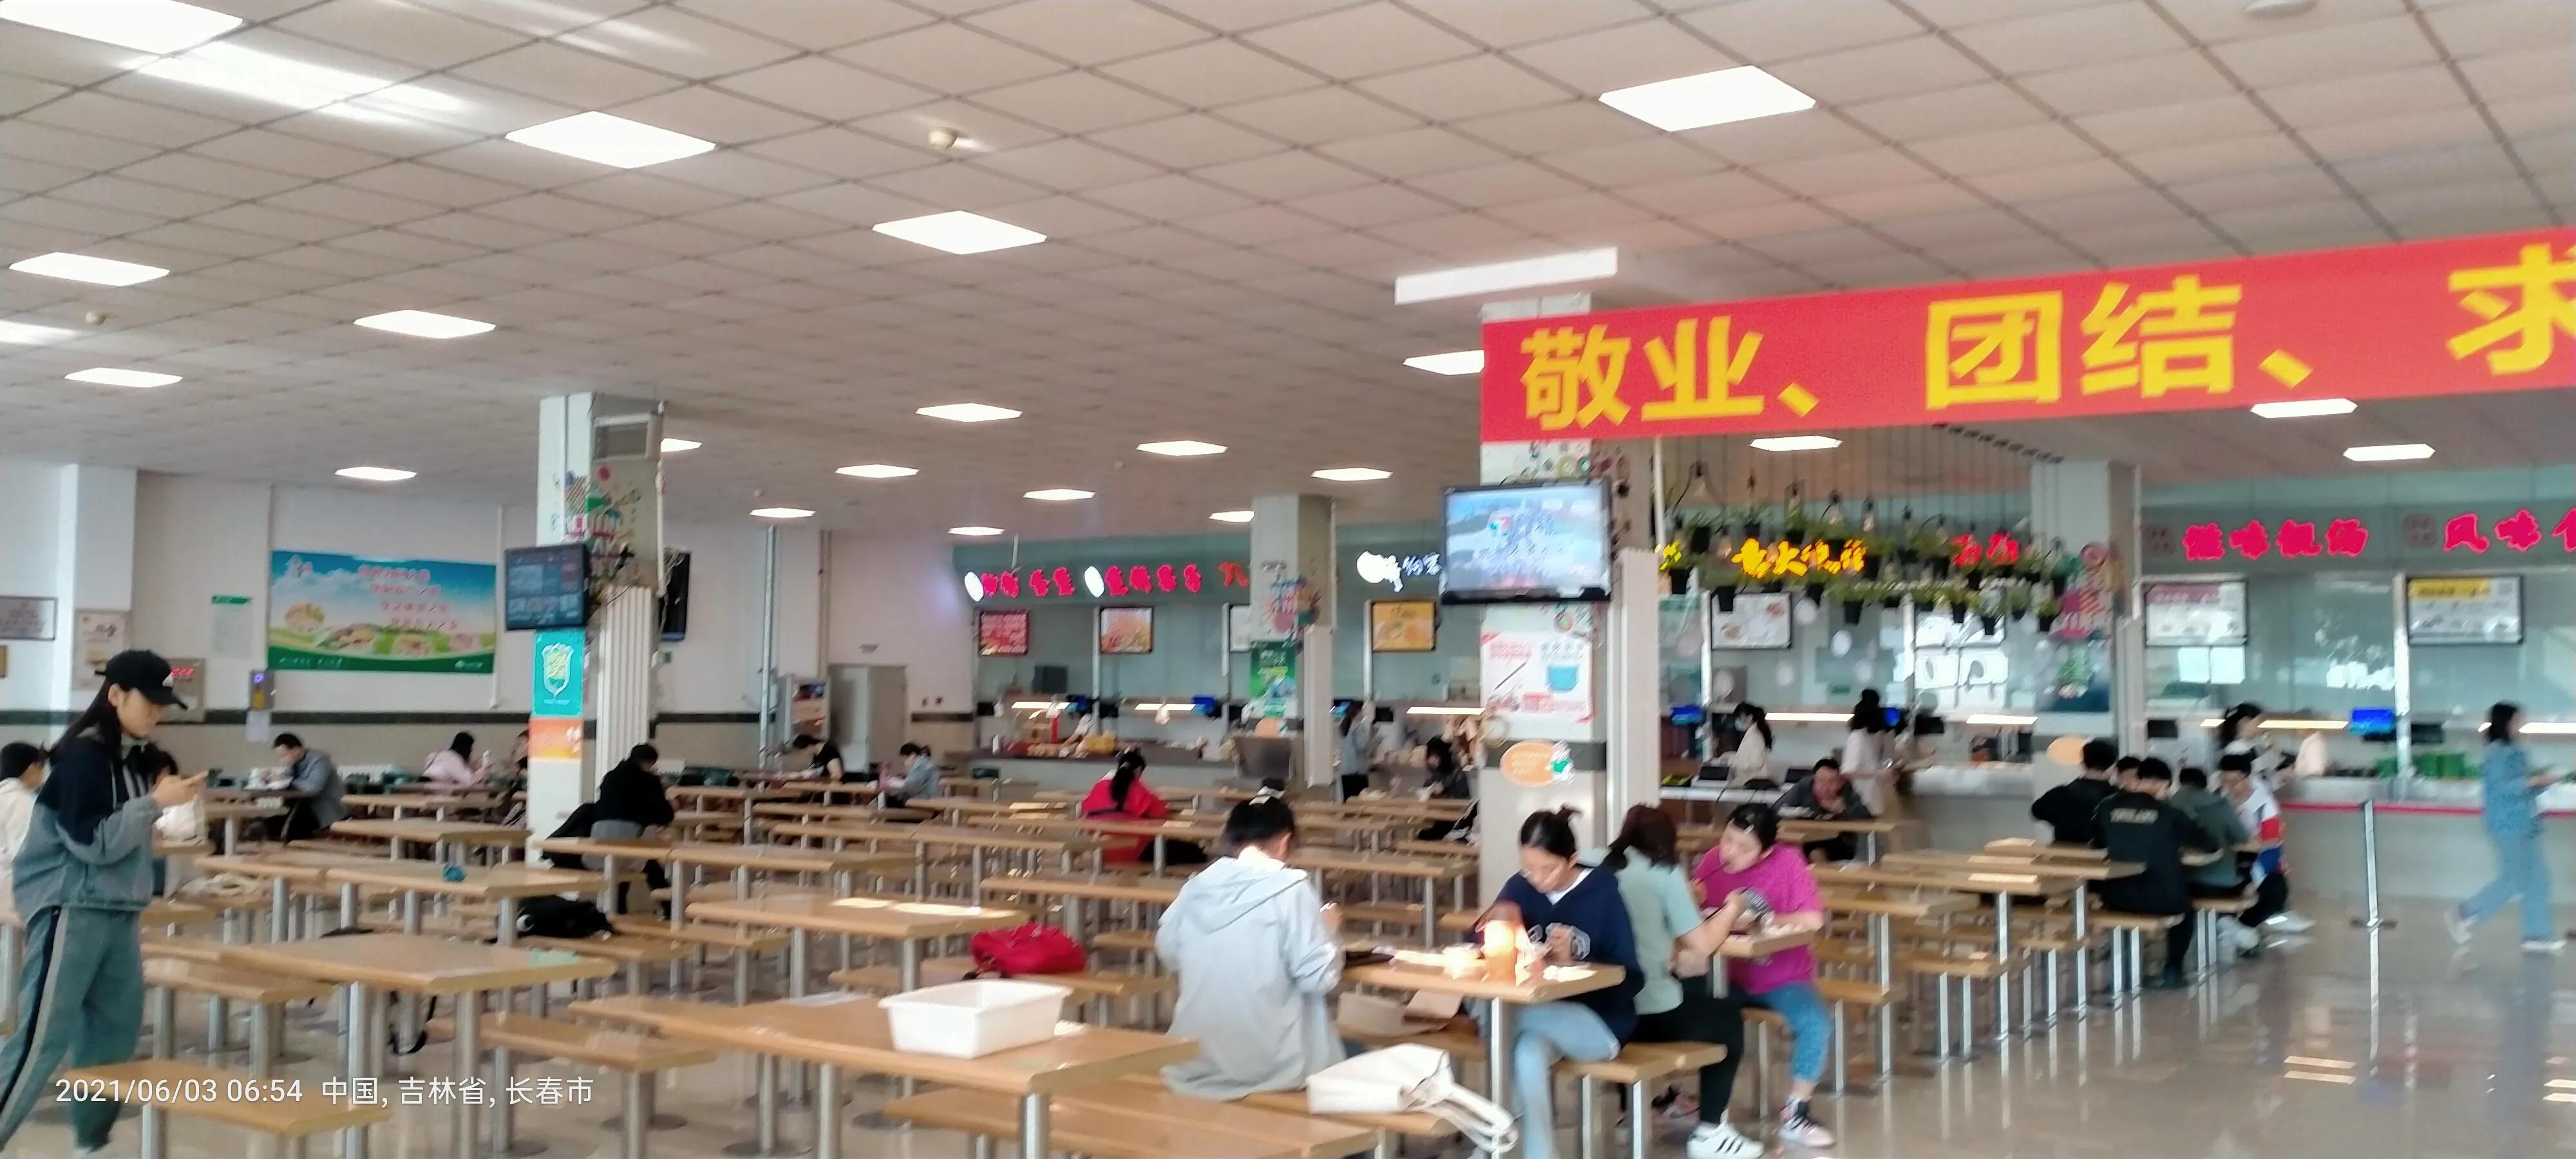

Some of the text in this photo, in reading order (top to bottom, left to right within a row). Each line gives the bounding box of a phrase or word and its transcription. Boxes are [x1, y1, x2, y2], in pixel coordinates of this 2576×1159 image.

[1520, 243, 2576, 430] 敬业、 团结、 求
